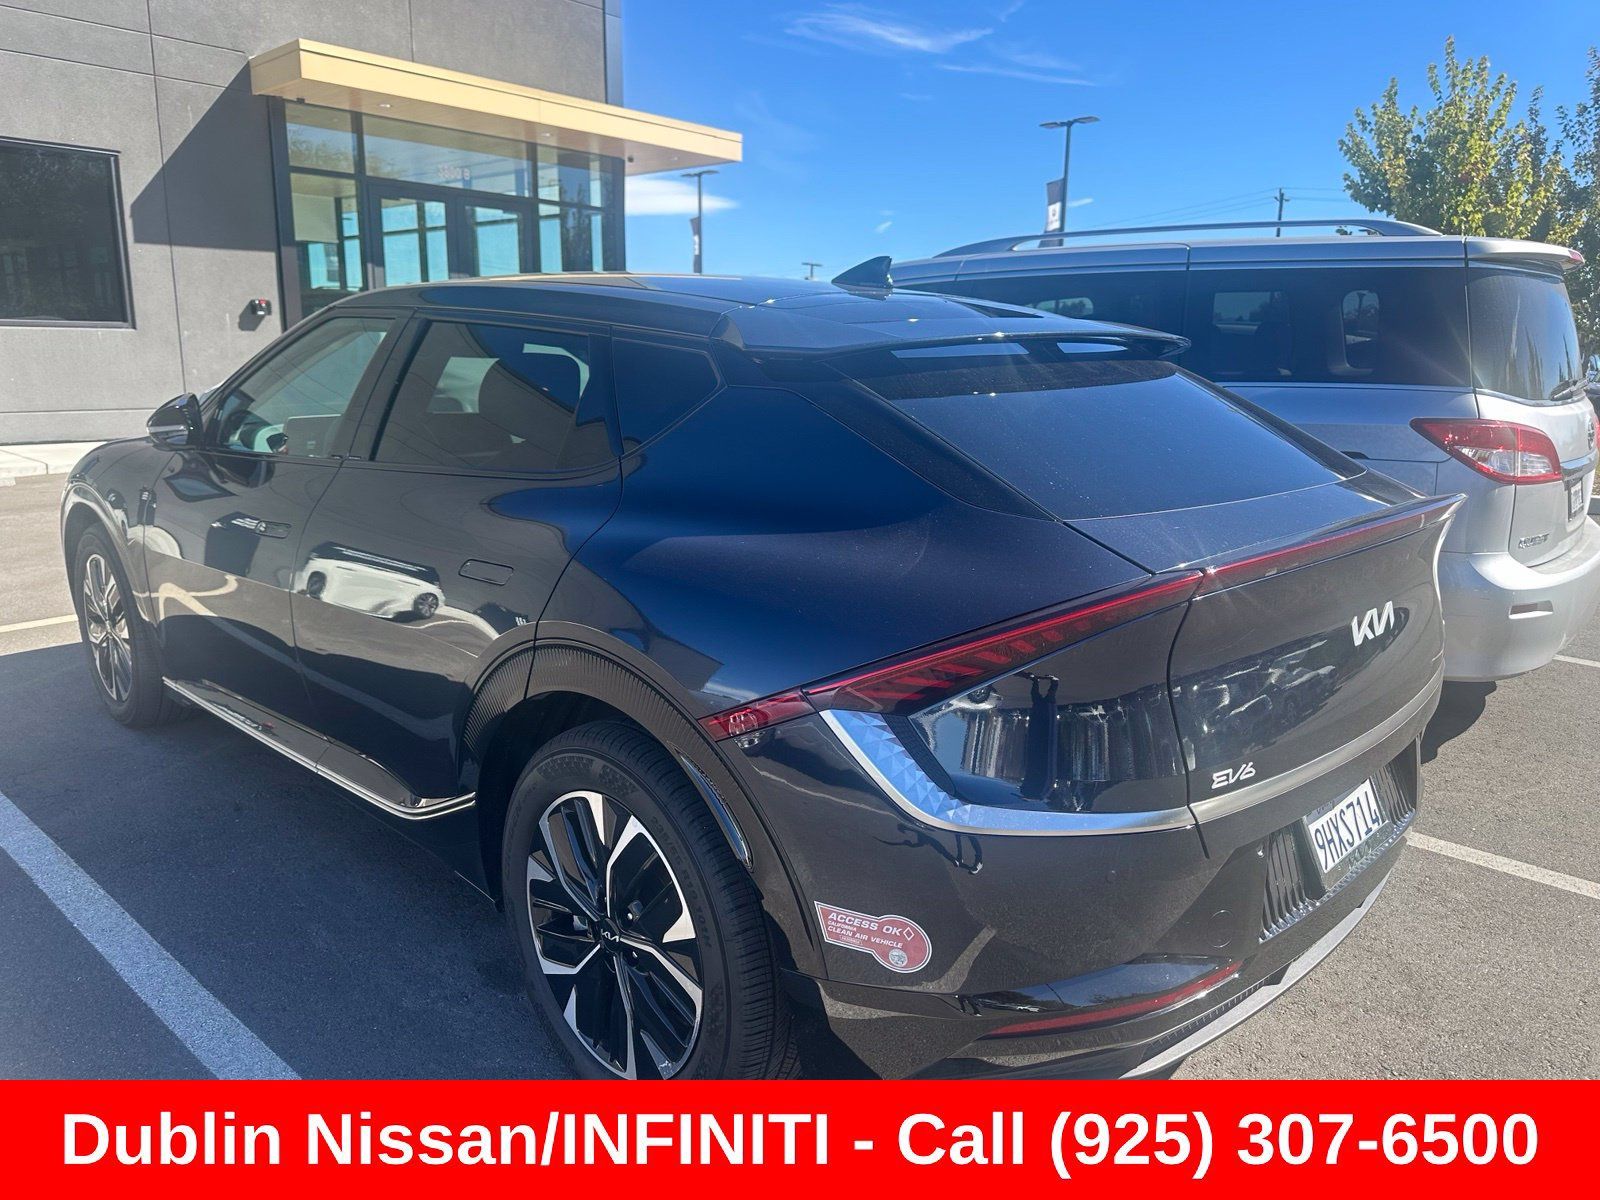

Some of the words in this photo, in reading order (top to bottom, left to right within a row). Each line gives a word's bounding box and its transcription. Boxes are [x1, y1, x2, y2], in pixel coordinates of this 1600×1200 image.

[1211, 762, 1256, 789] EV6
[1314, 790, 1381, 871] 9HXS714
[827, 920, 857, 932] CALIFORNIA
[827, 925, 853, 937] CLEAN
[854, 933, 869, 941] AIR
[870, 936, 904, 949] VEHICLE
[828, 912, 879, 931] ACCESS
[882, 925, 903, 937] OK
